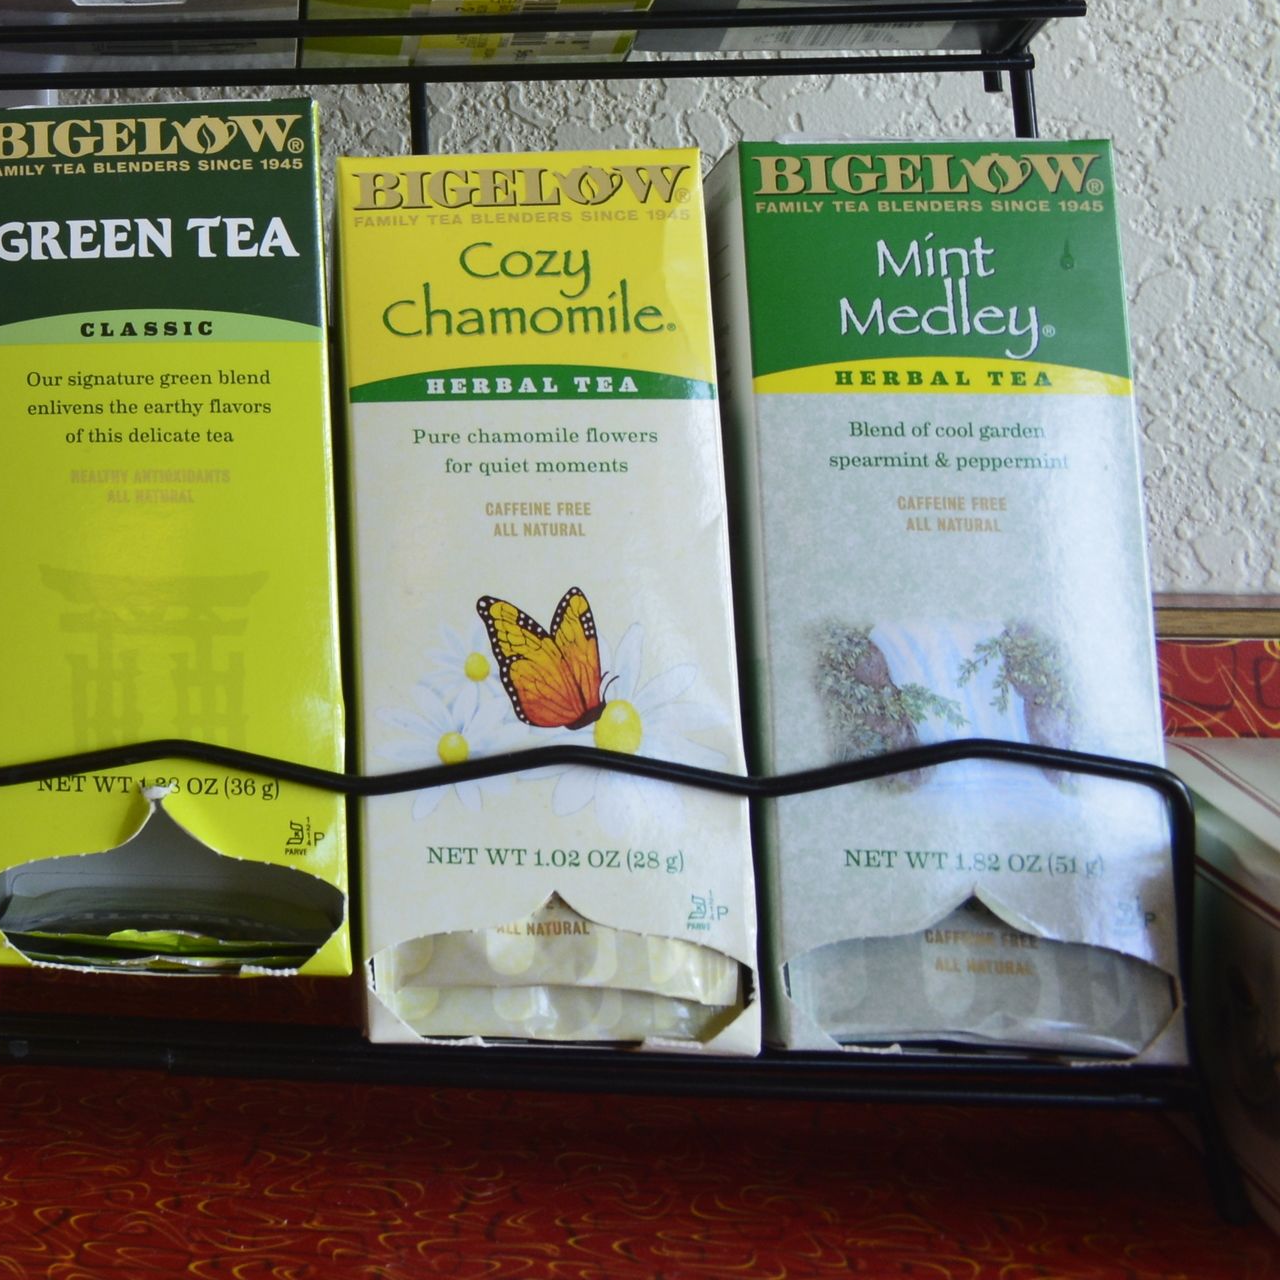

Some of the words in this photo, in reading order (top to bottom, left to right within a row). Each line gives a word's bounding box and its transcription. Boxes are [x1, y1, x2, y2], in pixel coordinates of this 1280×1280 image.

[52, 163, 86, 174] TEA
[94, 160, 190, 173] BLENDERS
[198, 159, 253, 171] SINCE
[260, 158, 303, 169] 1945
[753, 153, 1101, 196] BIGELOW
[352, 166, 690, 211] BIGELOW
[187, 216, 300, 257] TEA
[877, 233, 994, 278] Mint
[459, 242, 591, 300] Cozy
[382, 280, 663, 337] Chamomile
[81, 321, 212, 337] CLASSIC
[840, 278, 1040, 362] Medley
[427, 377, 558, 394] HERBAL
[574, 377, 638, 392] TEA
[835, 371, 970, 385] HERBAL
[987, 371, 1052, 387] TEA
[413, 429, 460, 444] Pure
[468, 428, 579, 443] chamomile
[587, 428, 657, 442] flowers
[446, 458, 472, 473] for
[479, 458, 528, 476] quiet
[536, 459, 628, 472] moments
[485, 502, 552, 516] CAFFEINE
[557, 502, 592, 516] FREE
[494, 523, 519, 537] ALL
[523, 523, 586, 537] NATURAL
